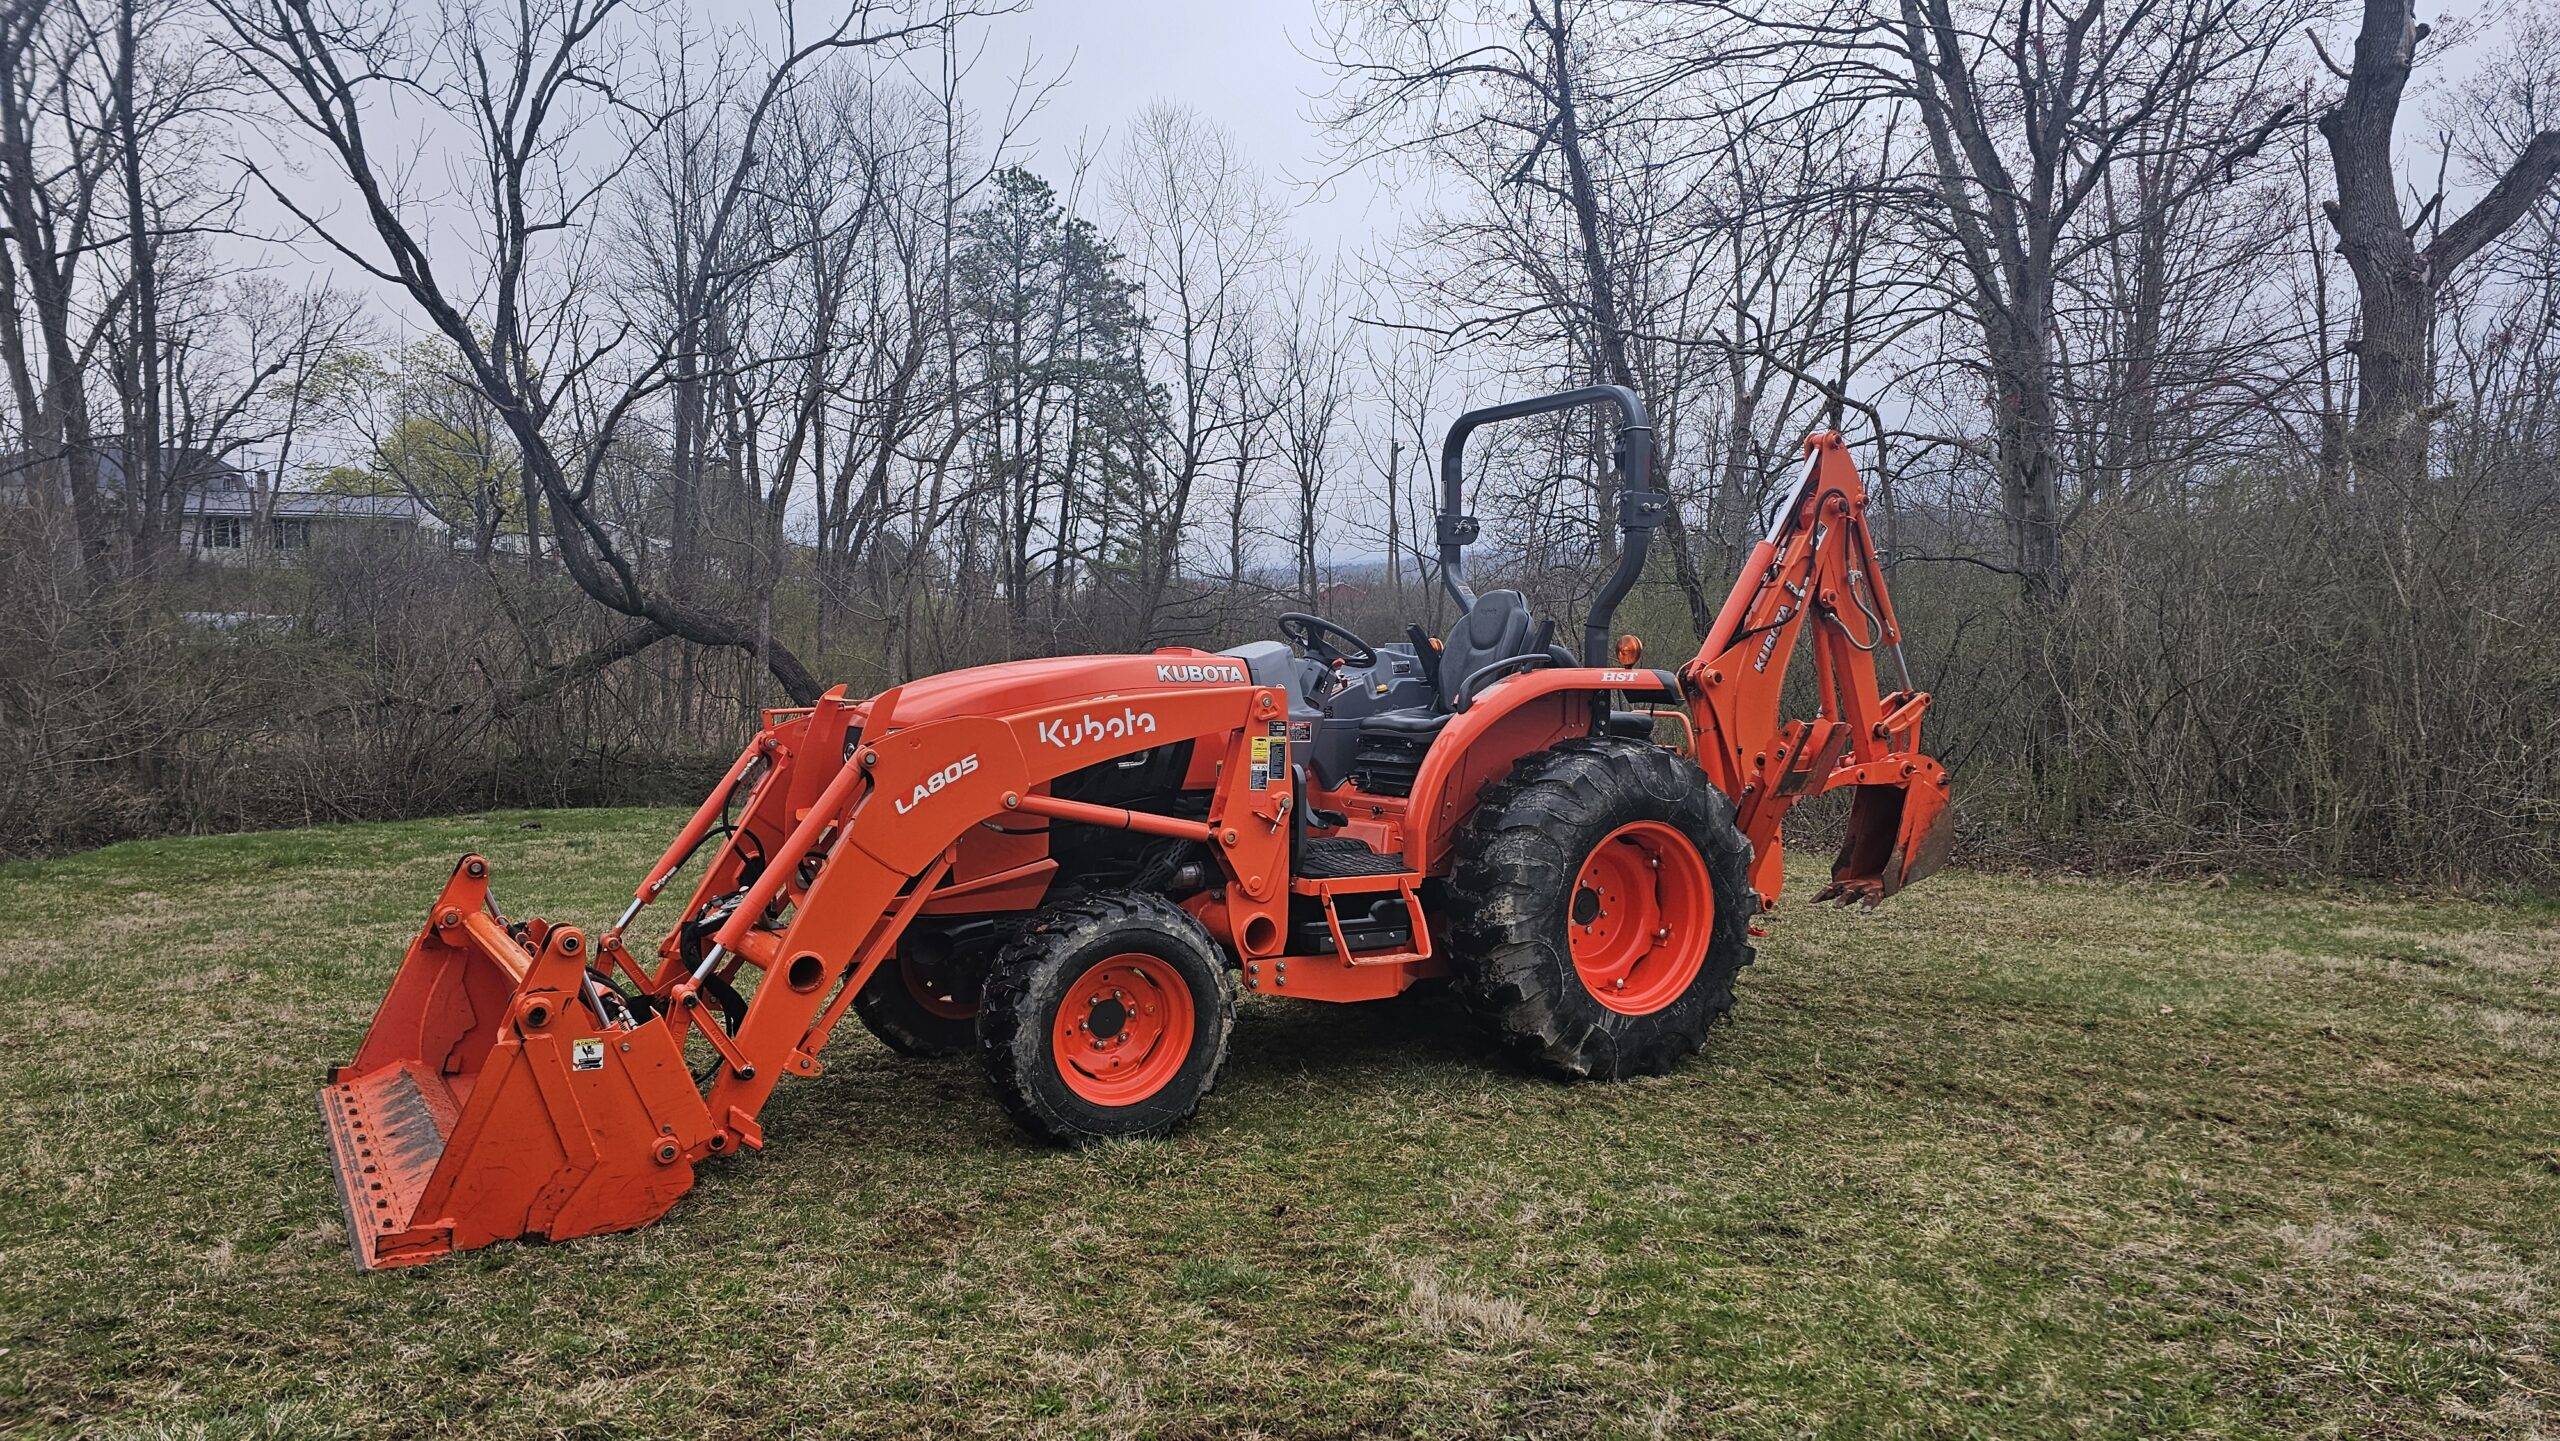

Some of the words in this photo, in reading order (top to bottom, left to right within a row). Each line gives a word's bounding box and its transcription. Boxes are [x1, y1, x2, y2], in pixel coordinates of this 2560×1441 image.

[1156, 664, 1244, 683] KUBOTA
[1601, 672, 1638, 682] HST
[1038, 708, 1155, 748] Kubota
[895, 753, 979, 815] LA805
